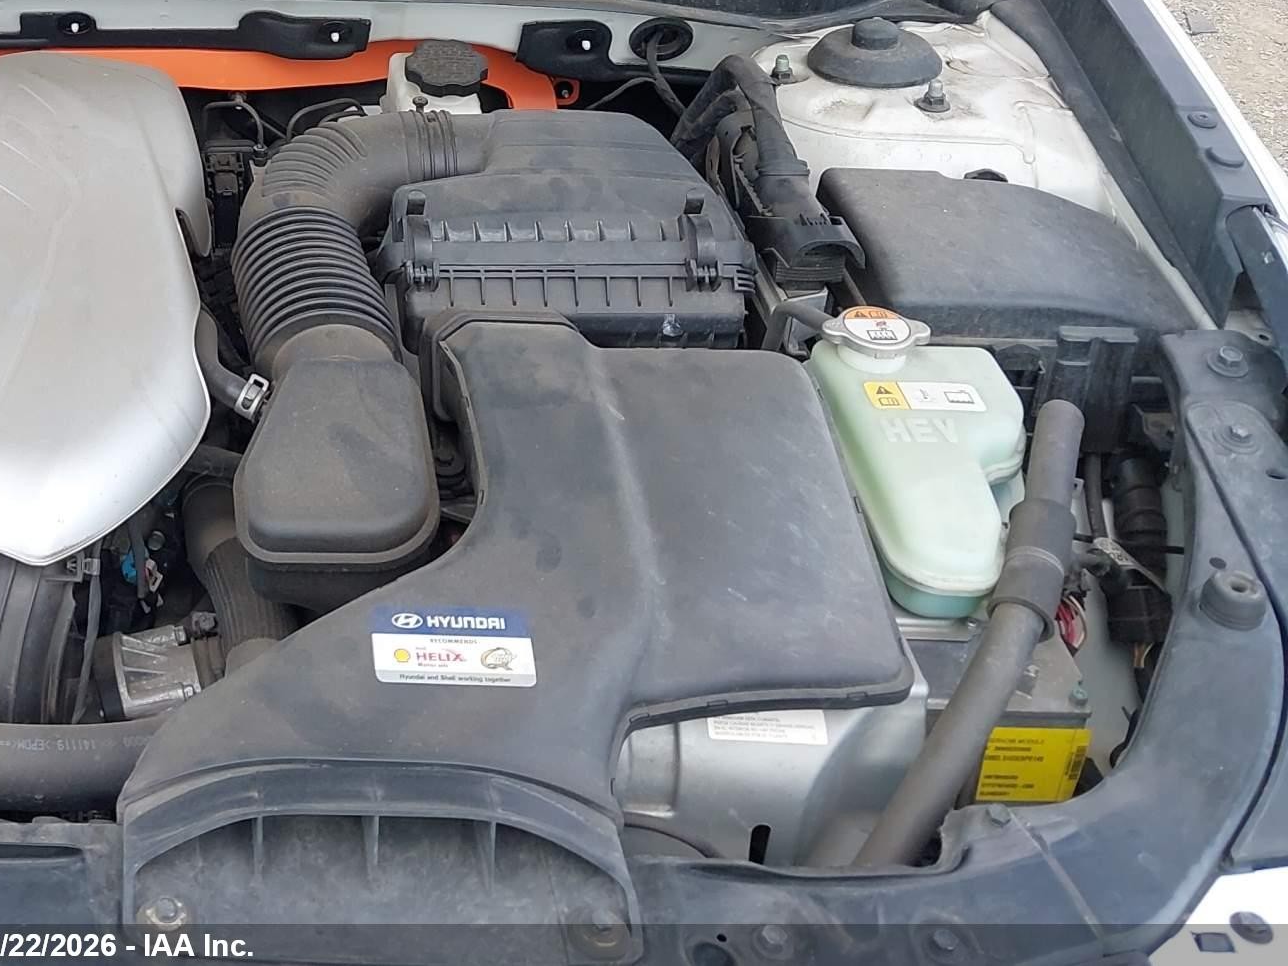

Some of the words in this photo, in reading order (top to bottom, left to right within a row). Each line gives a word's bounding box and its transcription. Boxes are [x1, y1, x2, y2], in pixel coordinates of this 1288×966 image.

[879, 417, 960, 443] HEV
[426, 616, 506, 630] HYUNDAI
[416, 651, 465, 662] HELIX
[399, 673, 425, 681] Hyundai
[458, 675, 484, 684] working
[485, 676, 511, 684] together
